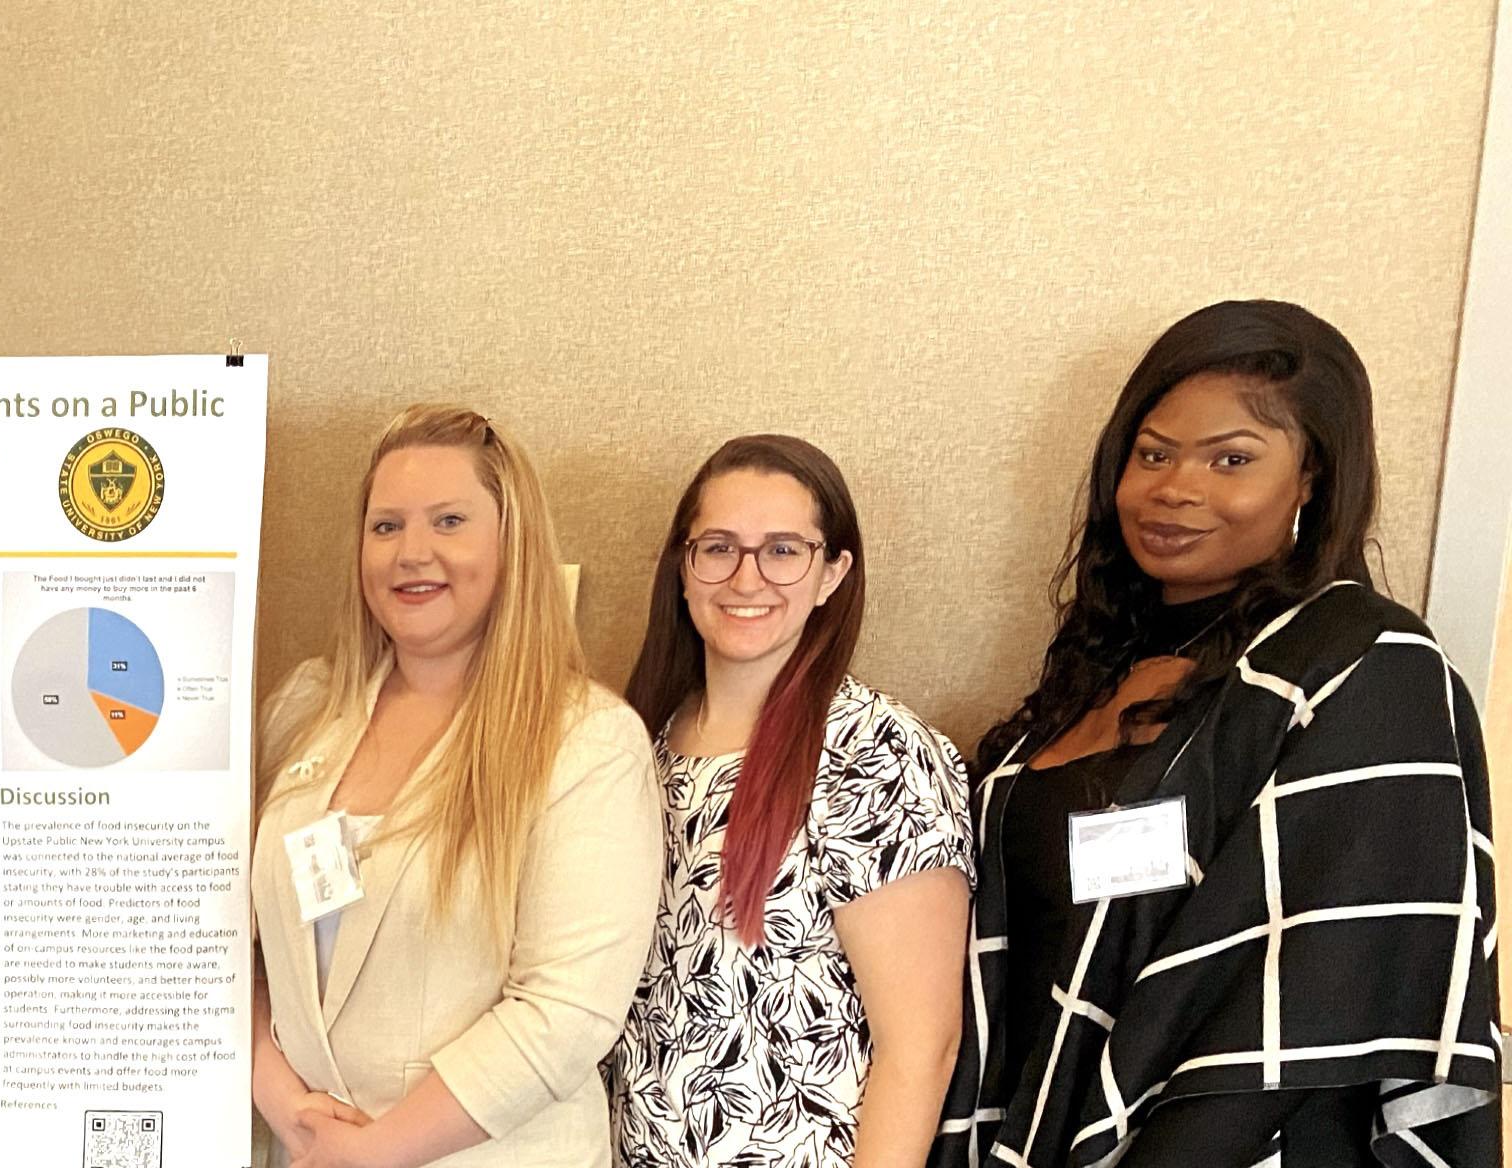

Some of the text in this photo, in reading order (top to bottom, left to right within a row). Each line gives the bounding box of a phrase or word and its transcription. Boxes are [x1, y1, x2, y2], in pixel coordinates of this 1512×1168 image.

[51, 396, 90, 418] on
[100, 396, 119, 418] a
[130, 388, 225, 418] Public
[87, 429, 140, 444] OSWEGO
[59, 453, 164, 541] STATE UNIVERSITY OF NEW YORK
[0, 786, 110, 806] Discussion
